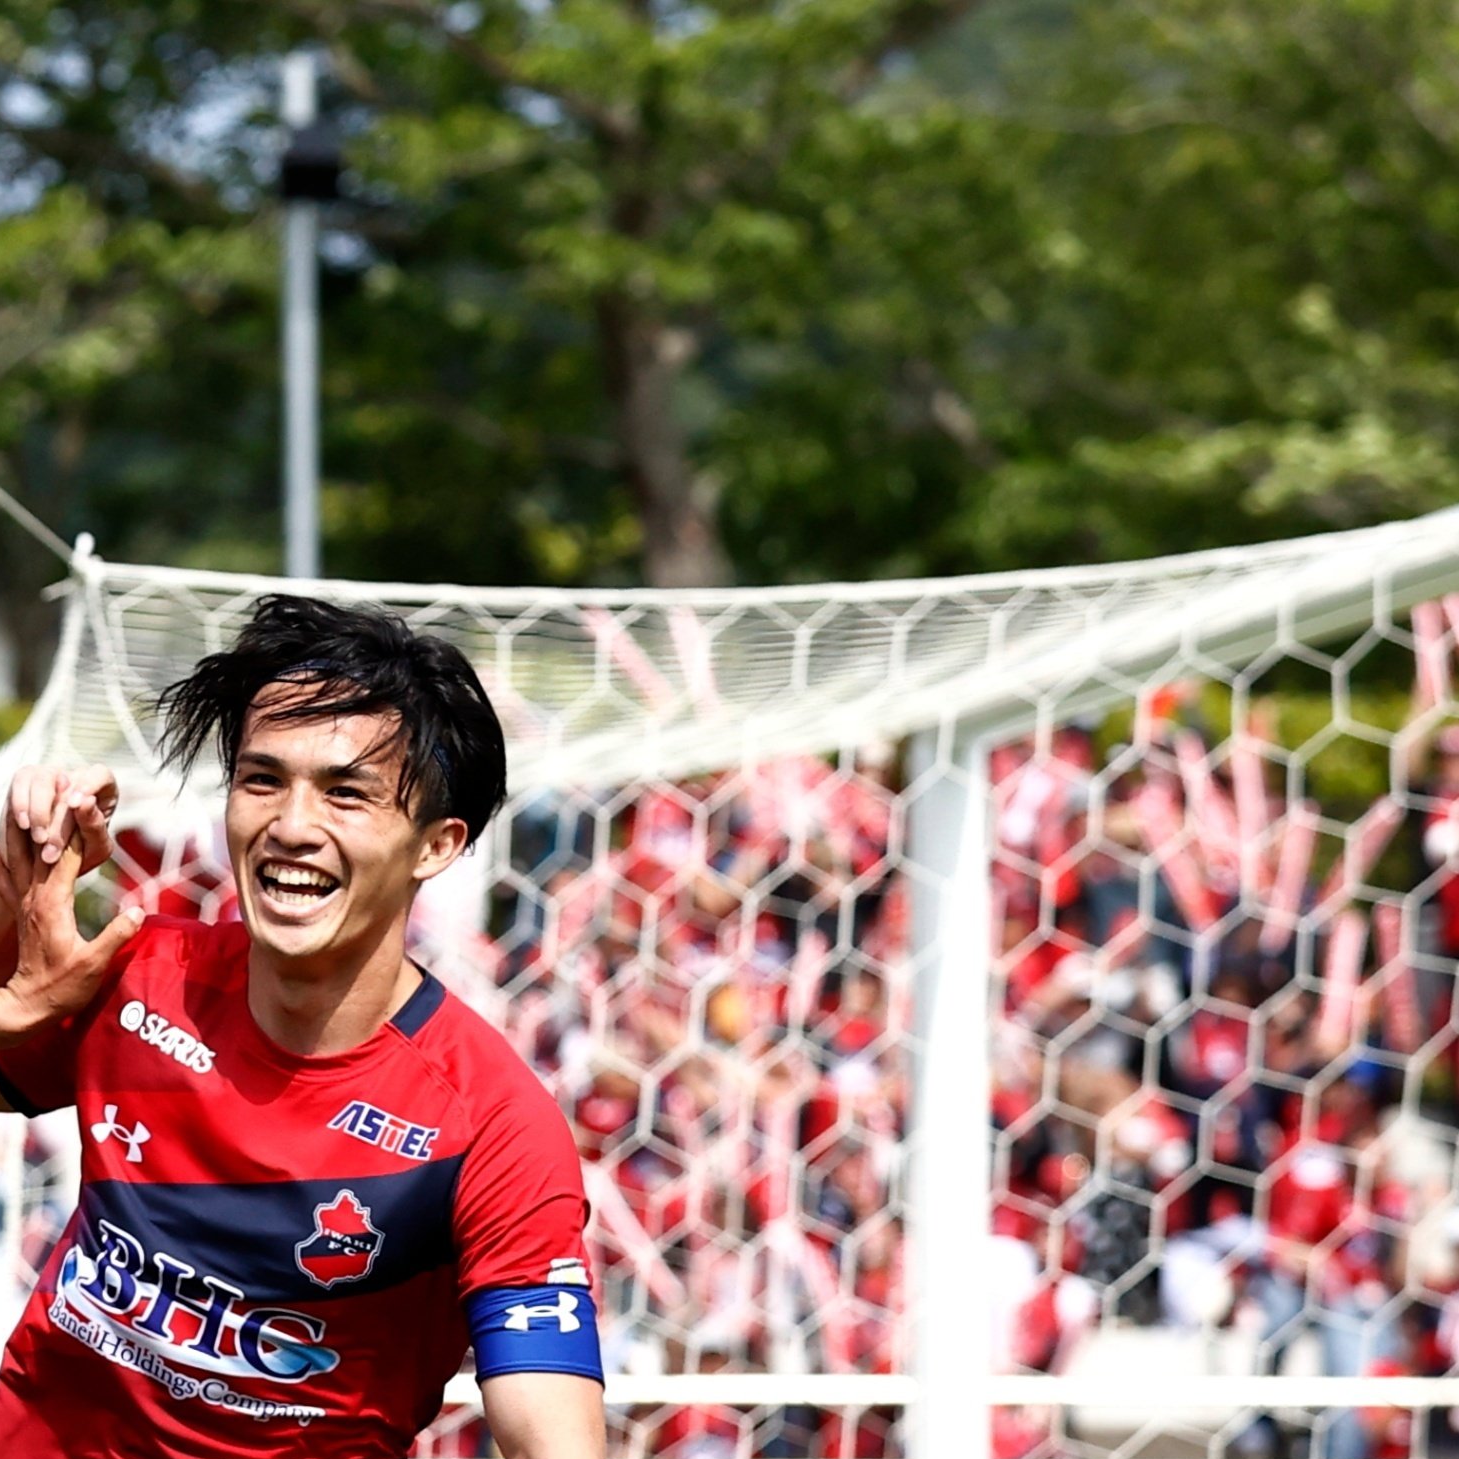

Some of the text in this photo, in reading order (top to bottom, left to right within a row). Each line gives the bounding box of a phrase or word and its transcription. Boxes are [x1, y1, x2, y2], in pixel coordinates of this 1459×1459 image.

[323, 1228, 372, 1251] IWAKI
[50, 1298, 95, 1345] Banei
[95, 1328, 197, 1397] Holdings
[78, 1221, 325, 1380] BHC
